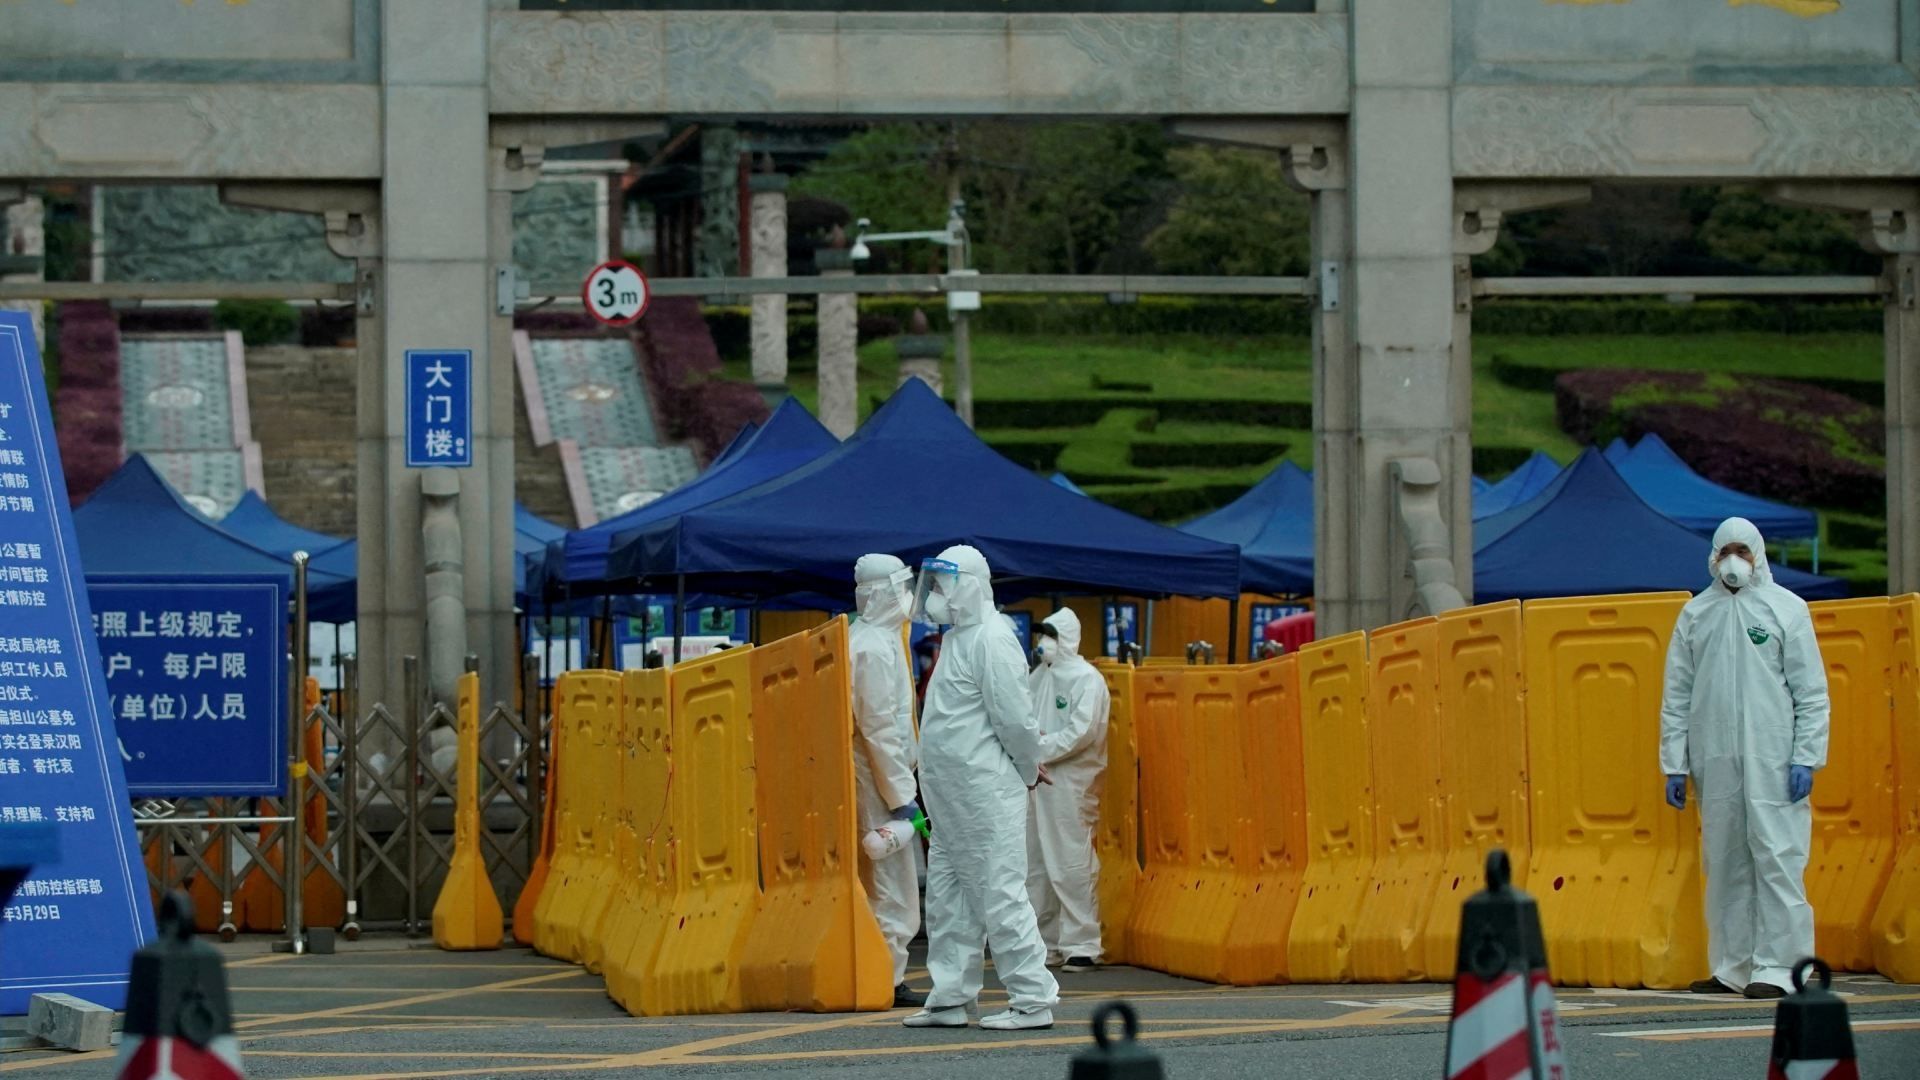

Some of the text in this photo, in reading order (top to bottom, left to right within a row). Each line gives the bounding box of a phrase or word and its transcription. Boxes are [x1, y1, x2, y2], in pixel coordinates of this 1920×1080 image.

[597, 277, 638, 308] 3m
[425, 360, 453, 457] 大门楼
[0, 473, 29, 488] 情防
[0, 543, 41, 559] 公墓暂
[0, 662, 67, 677] 织工作人员
[102, 652, 247, 679] 户，每户限
[0, 734, 81, 749] 实名登录汉阳
[0, 806, 94, 822] 界理解、支持和
[4, 905, 60, 921] 年3月29日
